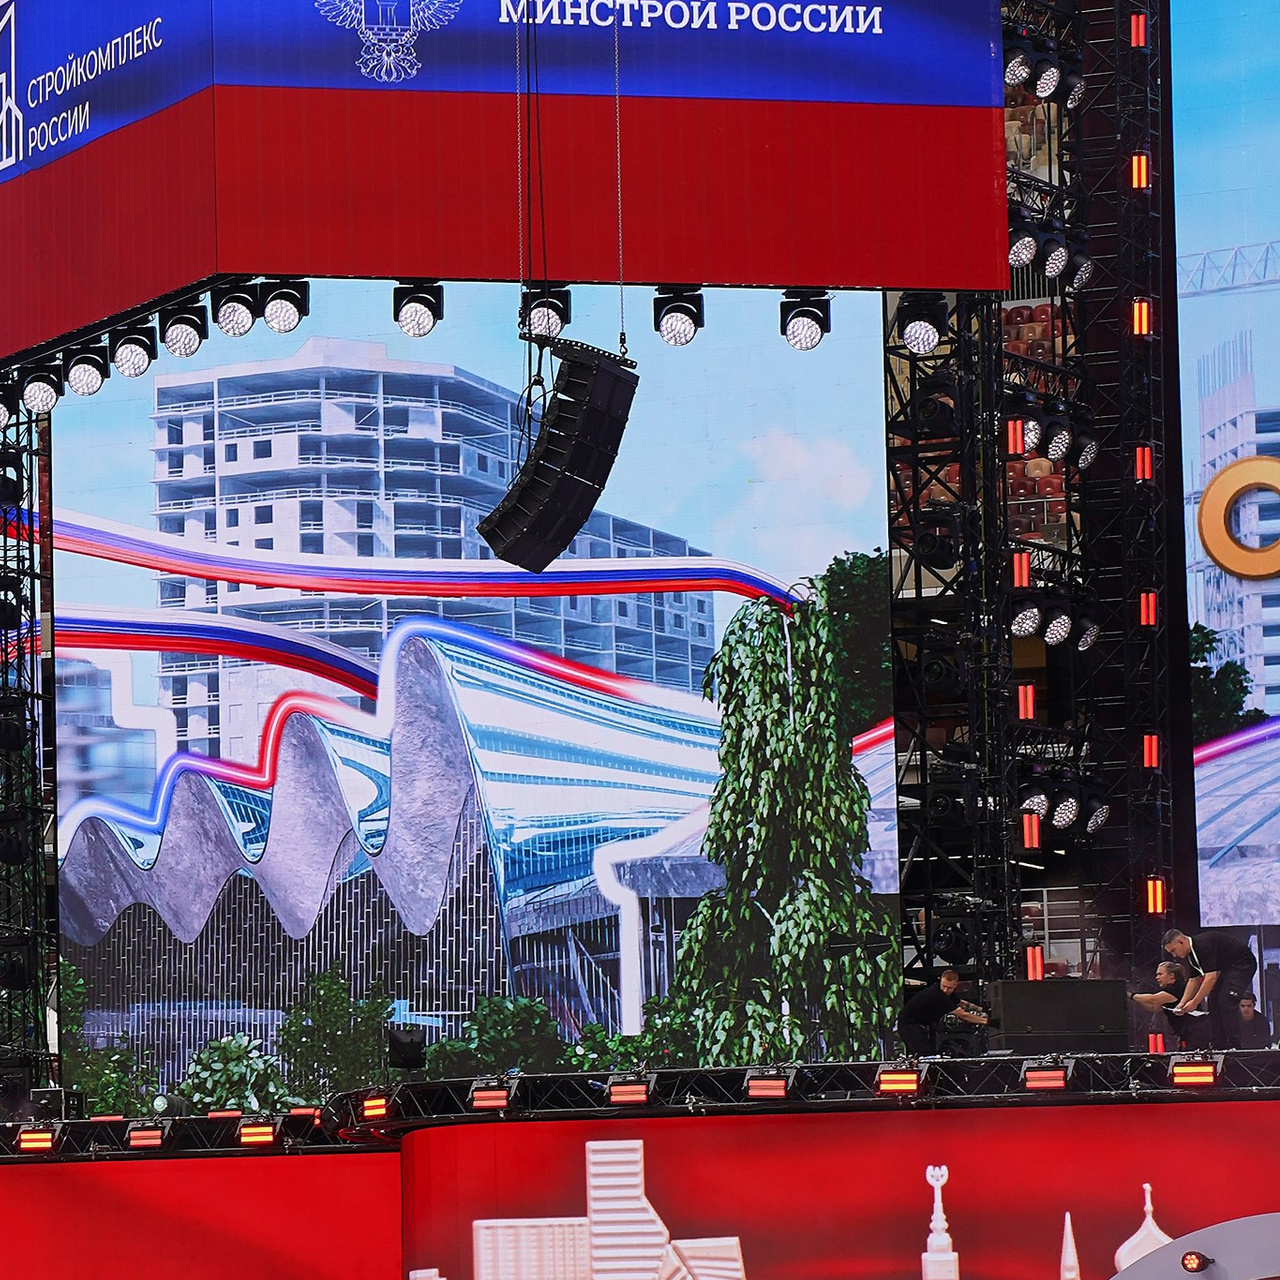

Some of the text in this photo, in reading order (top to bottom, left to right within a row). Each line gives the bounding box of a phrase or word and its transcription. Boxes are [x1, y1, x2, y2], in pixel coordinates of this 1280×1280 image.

[727, 1, 884, 34] РОССИИ
[27, 17, 163, 109] СТРОЙКОМПЛЕКС
[28, 101, 90, 156] РОССИИ
